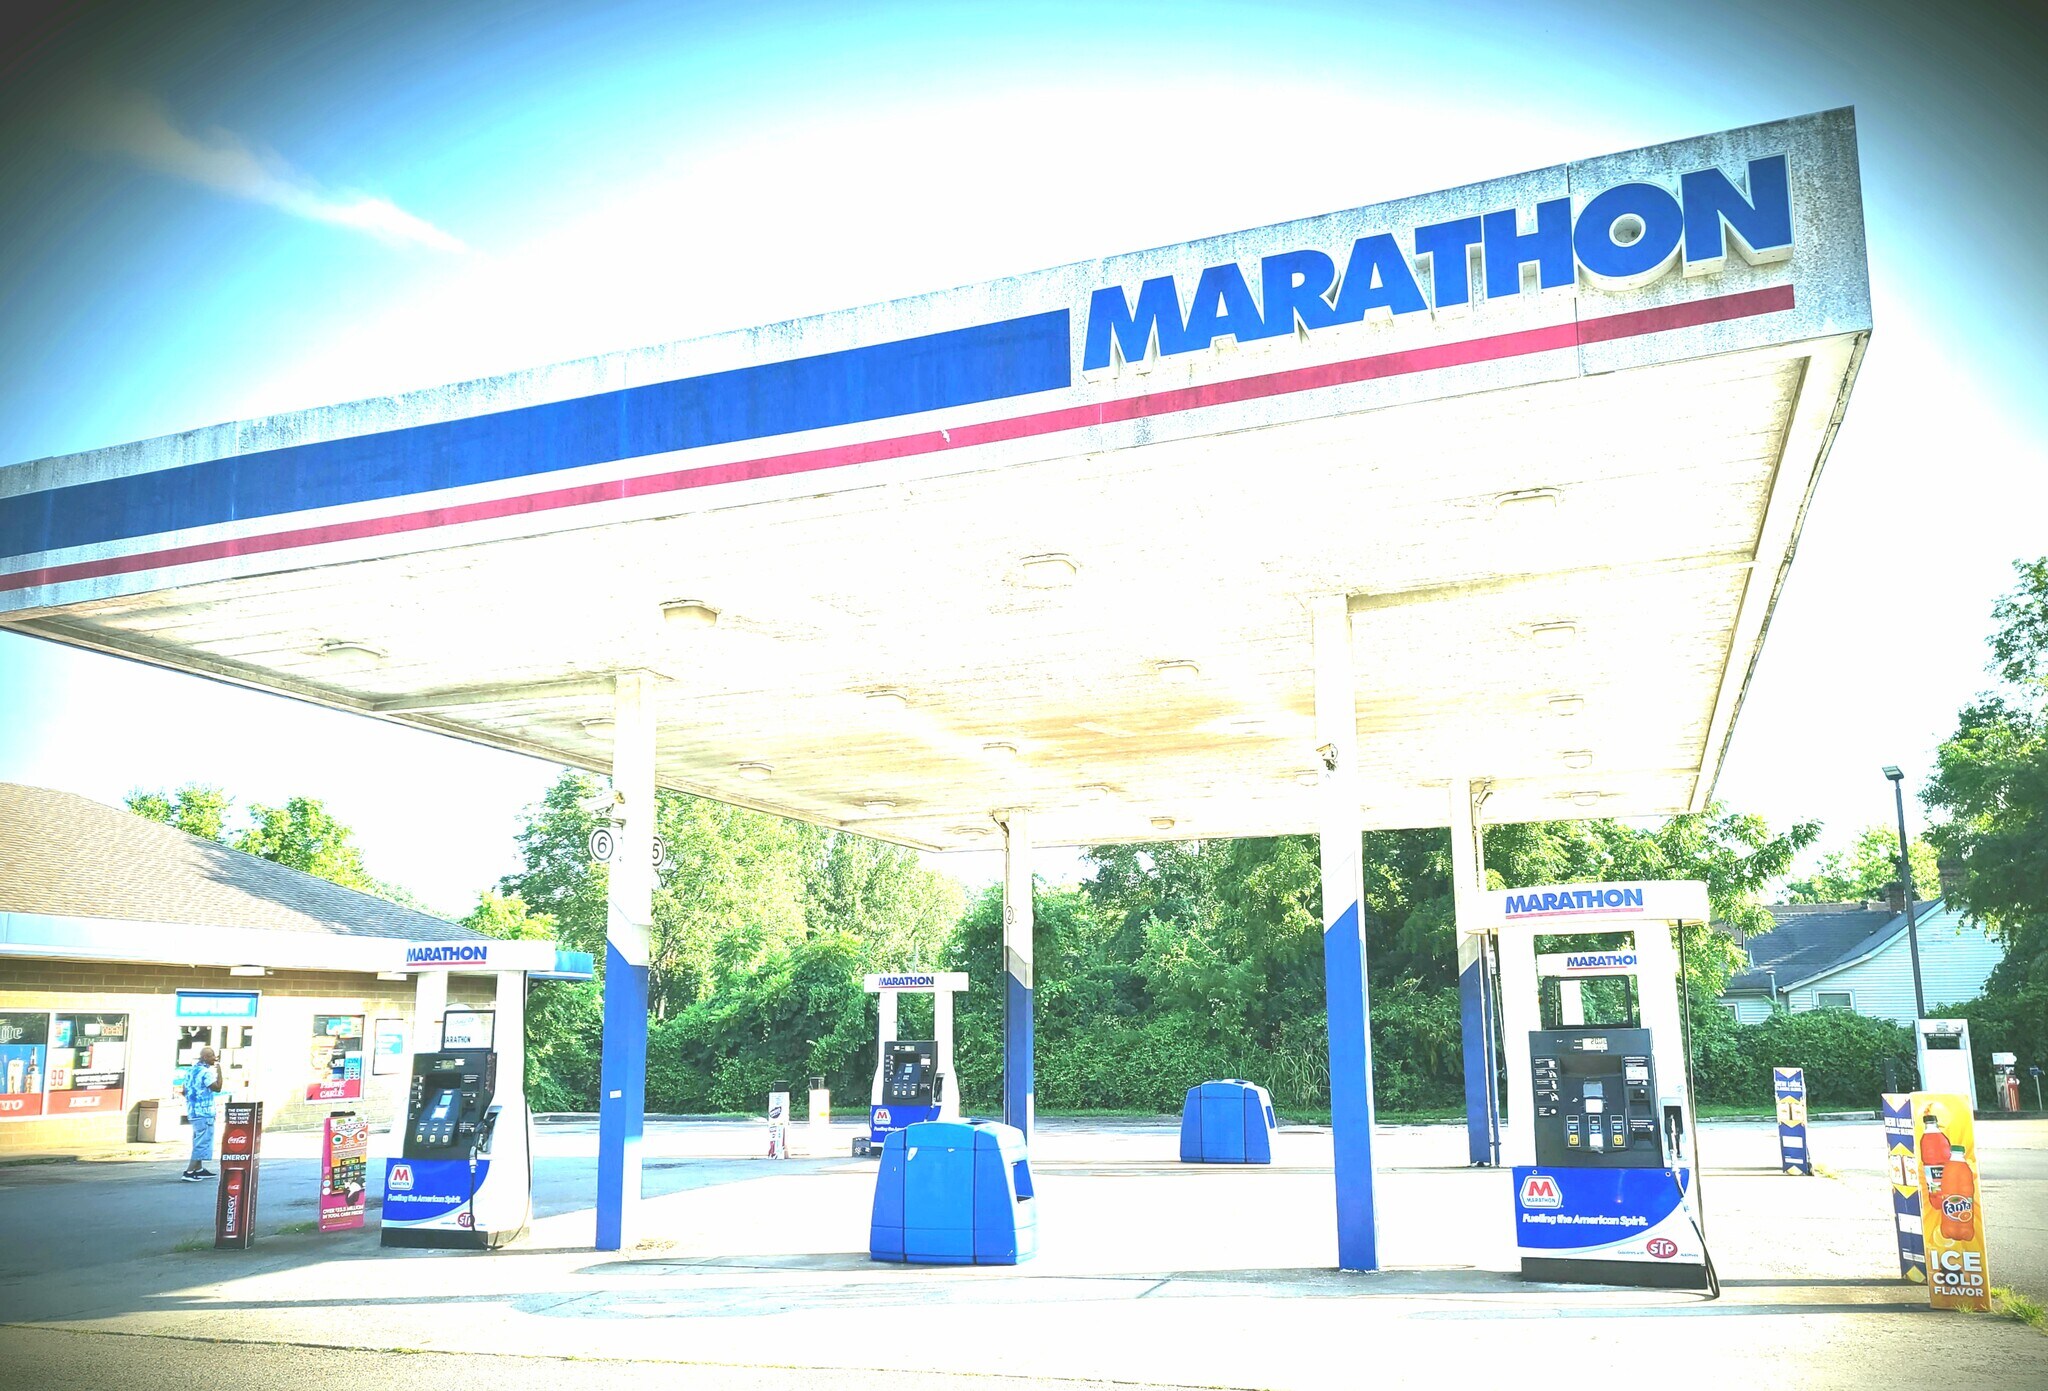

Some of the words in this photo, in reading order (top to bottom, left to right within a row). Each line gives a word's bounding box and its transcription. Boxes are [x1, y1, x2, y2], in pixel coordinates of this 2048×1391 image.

[1082, 152, 1794, 373] MARATHON
[598, 836, 608, 853] 6
[652, 843, 660, 859] 5
[1505, 888, 1644, 914] MARATHON
[406, 946, 487, 962] MARATHON
[878, 976, 934, 986] MARATHON
[393, 1169, 409, 1181] M
[1528, 1181, 1554, 1197] M
[387, 1193, 408, 1203] Fueling
[407, 1194, 417, 1202] the
[416, 1195, 445, 1203] American
[226, 1195, 235, 1232] ENERGY
[1522, 1213, 1557, 1225] Fueling
[1556, 1214, 1573, 1224] the
[1573, 1214, 1620, 1226] American
[1619, 1216, 1649, 1227] Spirit.
[1650, 1240, 1674, 1255] STP
[1930, 1250, 1982, 1272] ICE
[1932, 1272, 1984, 1286] COLD
[1934, 1286, 1984, 1297] FLAVOR
